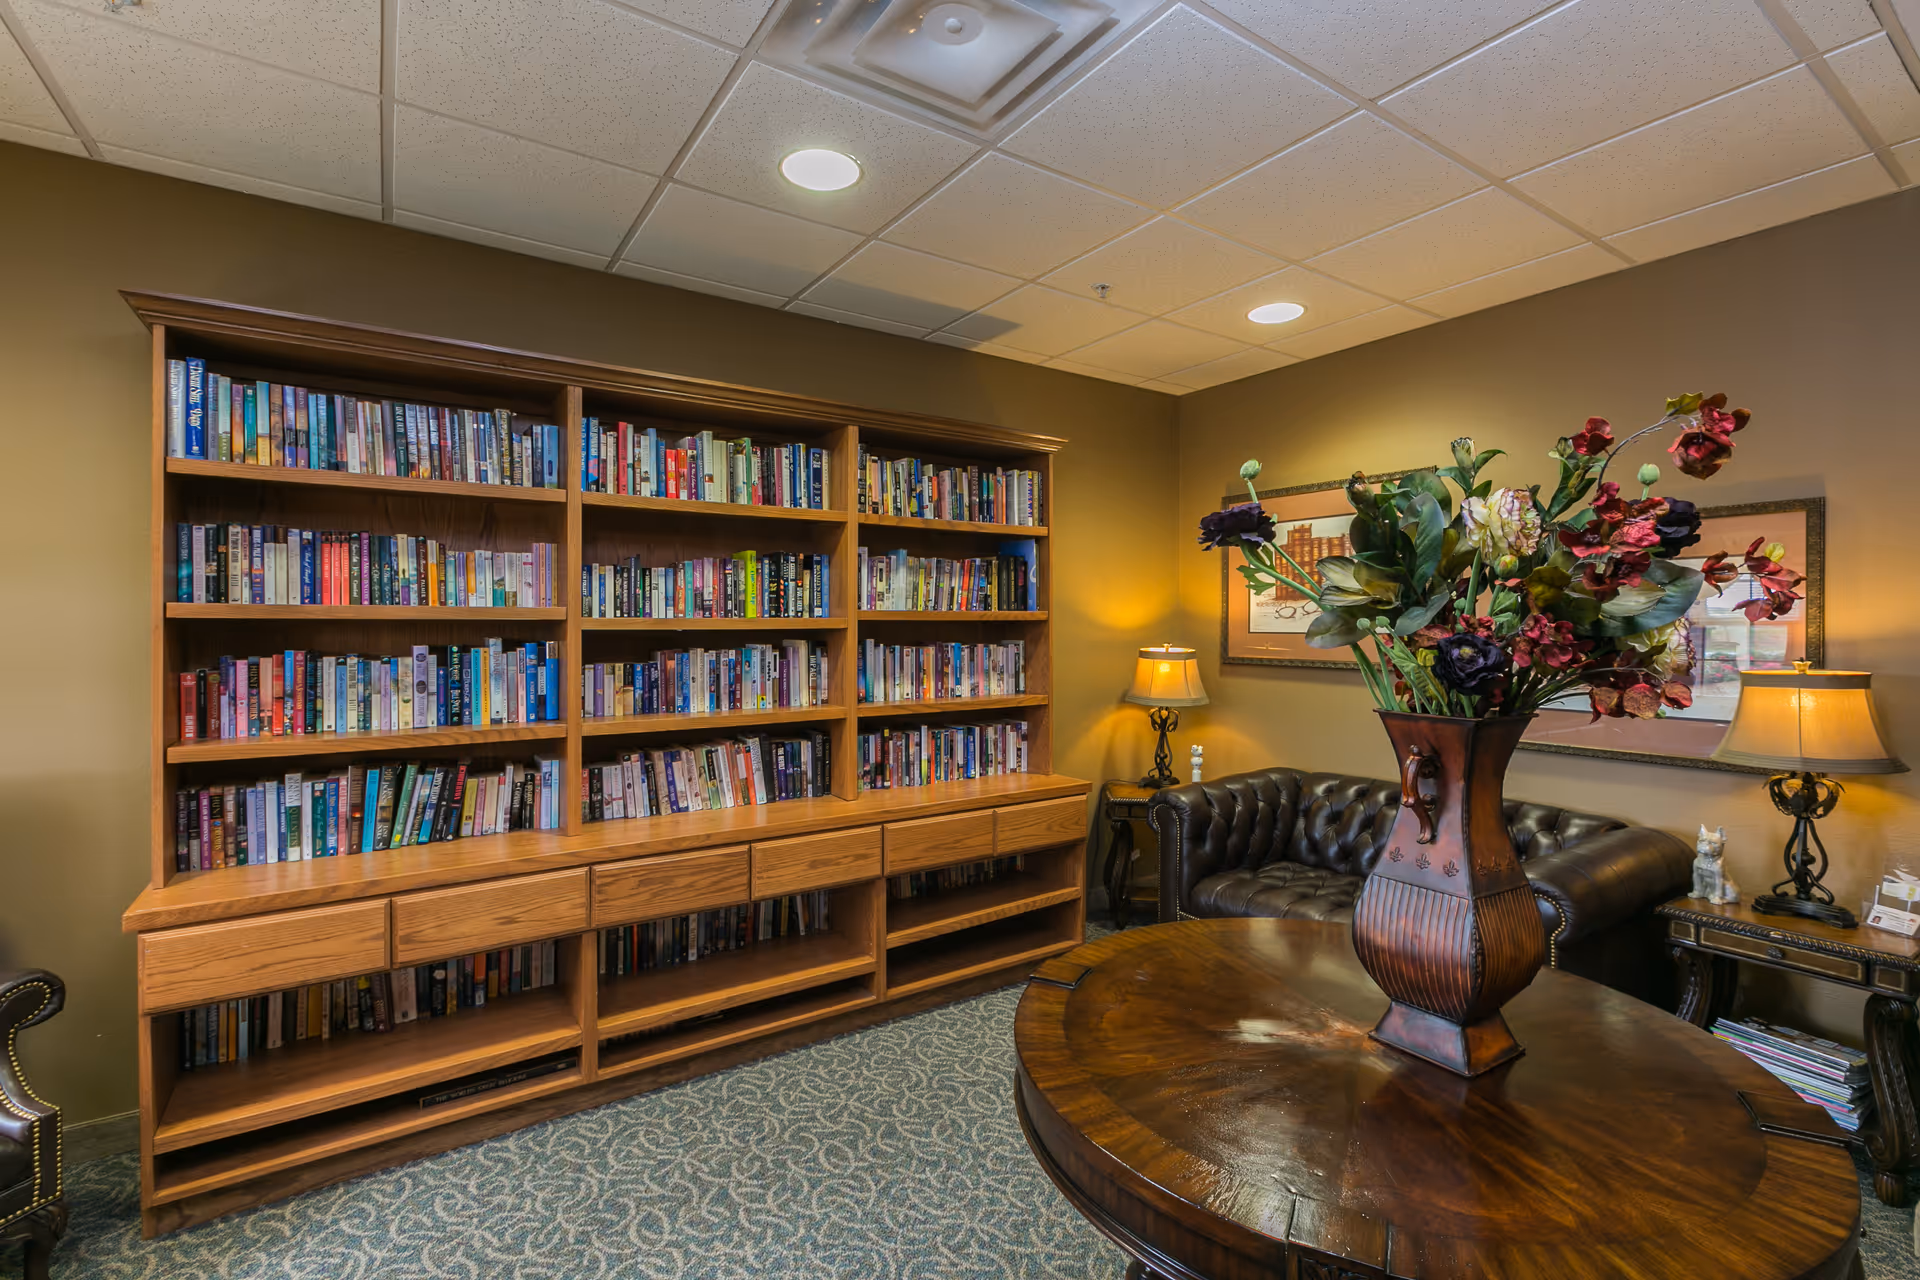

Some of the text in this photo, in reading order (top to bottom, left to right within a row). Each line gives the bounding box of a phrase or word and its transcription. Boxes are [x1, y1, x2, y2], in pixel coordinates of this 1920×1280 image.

[249, 665, 258, 687] HUNT
[809, 655, 817, 681] IMPACT
[211, 795, 222, 819] HUNT
[289, 807, 299, 848] QUENTIN
